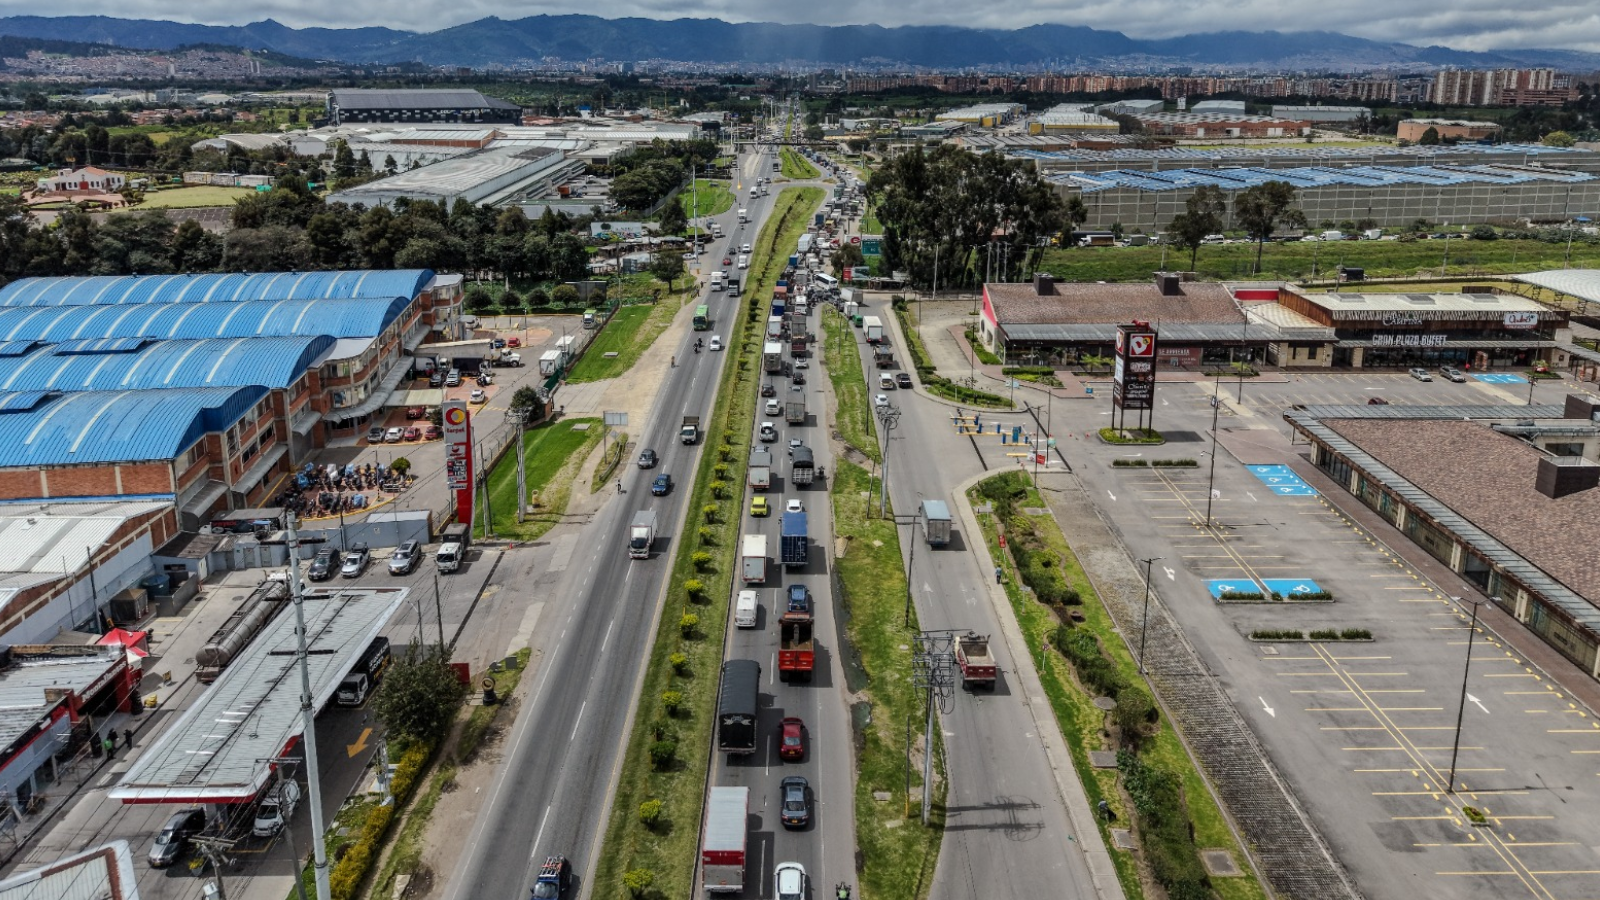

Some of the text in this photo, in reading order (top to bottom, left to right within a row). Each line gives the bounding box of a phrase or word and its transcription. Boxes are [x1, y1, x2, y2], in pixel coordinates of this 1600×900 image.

[1372, 334, 1448, 346] GRAN PLAZA BUFFET
